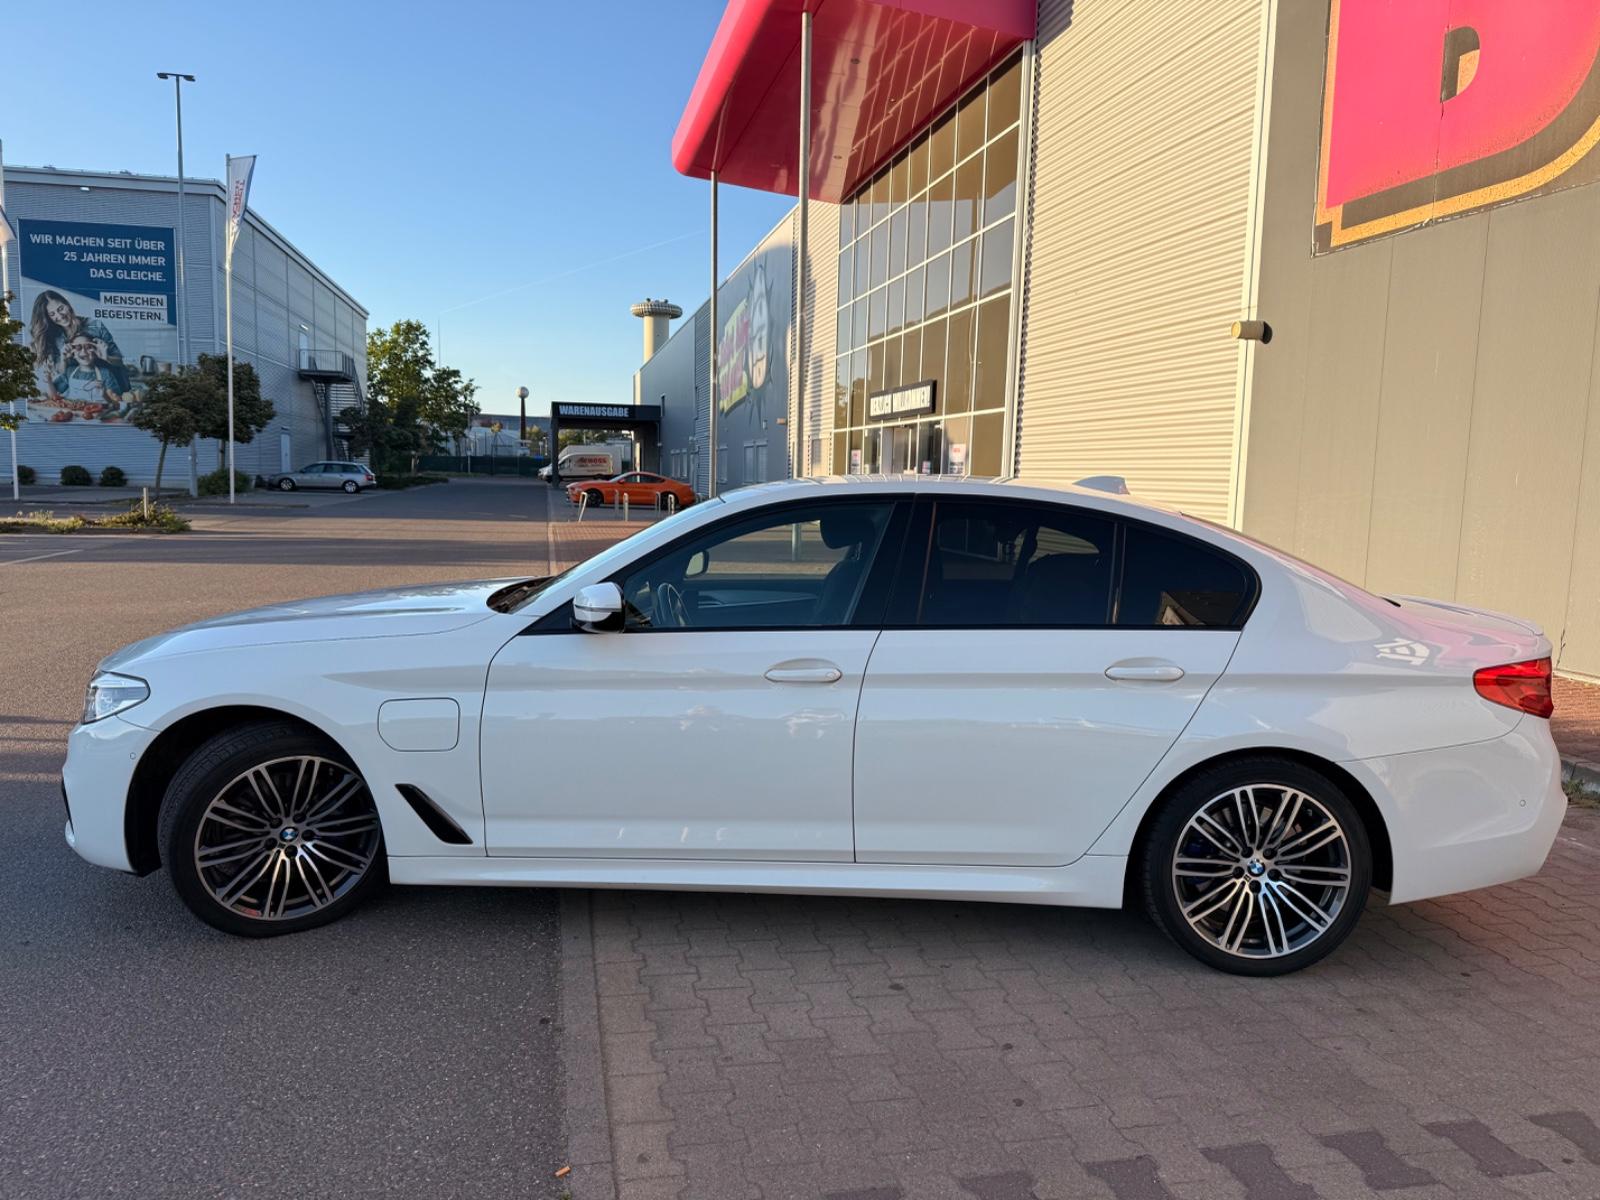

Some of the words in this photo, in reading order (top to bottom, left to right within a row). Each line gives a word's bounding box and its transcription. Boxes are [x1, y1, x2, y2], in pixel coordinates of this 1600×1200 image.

[30, 233, 53, 244] WIR
[56, 235, 104, 247] MACHEN
[107, 238, 132, 249] SEIT
[135, 237, 165, 251] ÜBER
[64, 251, 77, 262] 25
[80, 252, 126, 264] JAHREN
[128, 255, 166, 266] IMMER
[90, 268, 113, 279] DAS
[116, 270, 166, 282] GLEICHE.
[103, 295, 164, 307] MENSCHEN
[94, 309, 165, 321] BEGEISTERN.
[559, 405, 629, 417] WARENAUSGABE
